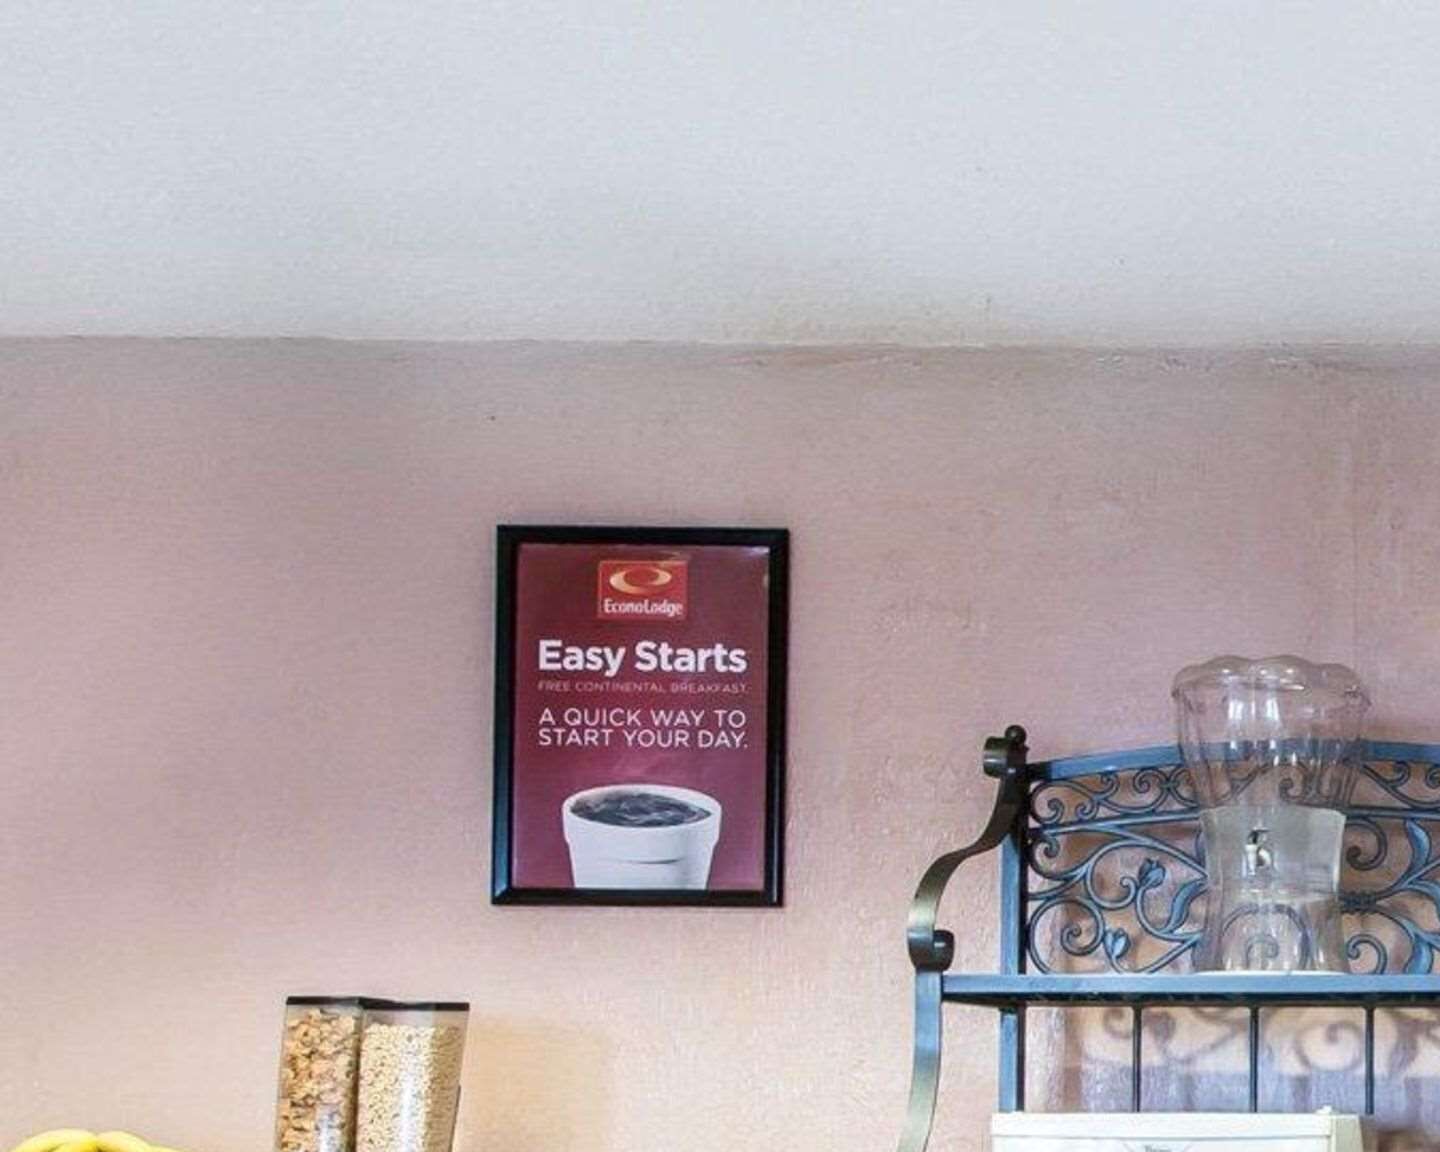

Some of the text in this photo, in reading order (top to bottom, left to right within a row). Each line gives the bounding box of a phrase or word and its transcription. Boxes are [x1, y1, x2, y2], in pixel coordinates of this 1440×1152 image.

[603, 597, 684, 617] EconoLodge
[538, 640, 748, 677] Easy Starts
[575, 681, 665, 693] CONTINENTAL
[539, 707, 746, 729] A QUICK WAY TO
[538, 727, 748, 749] START YOUR DAY.
